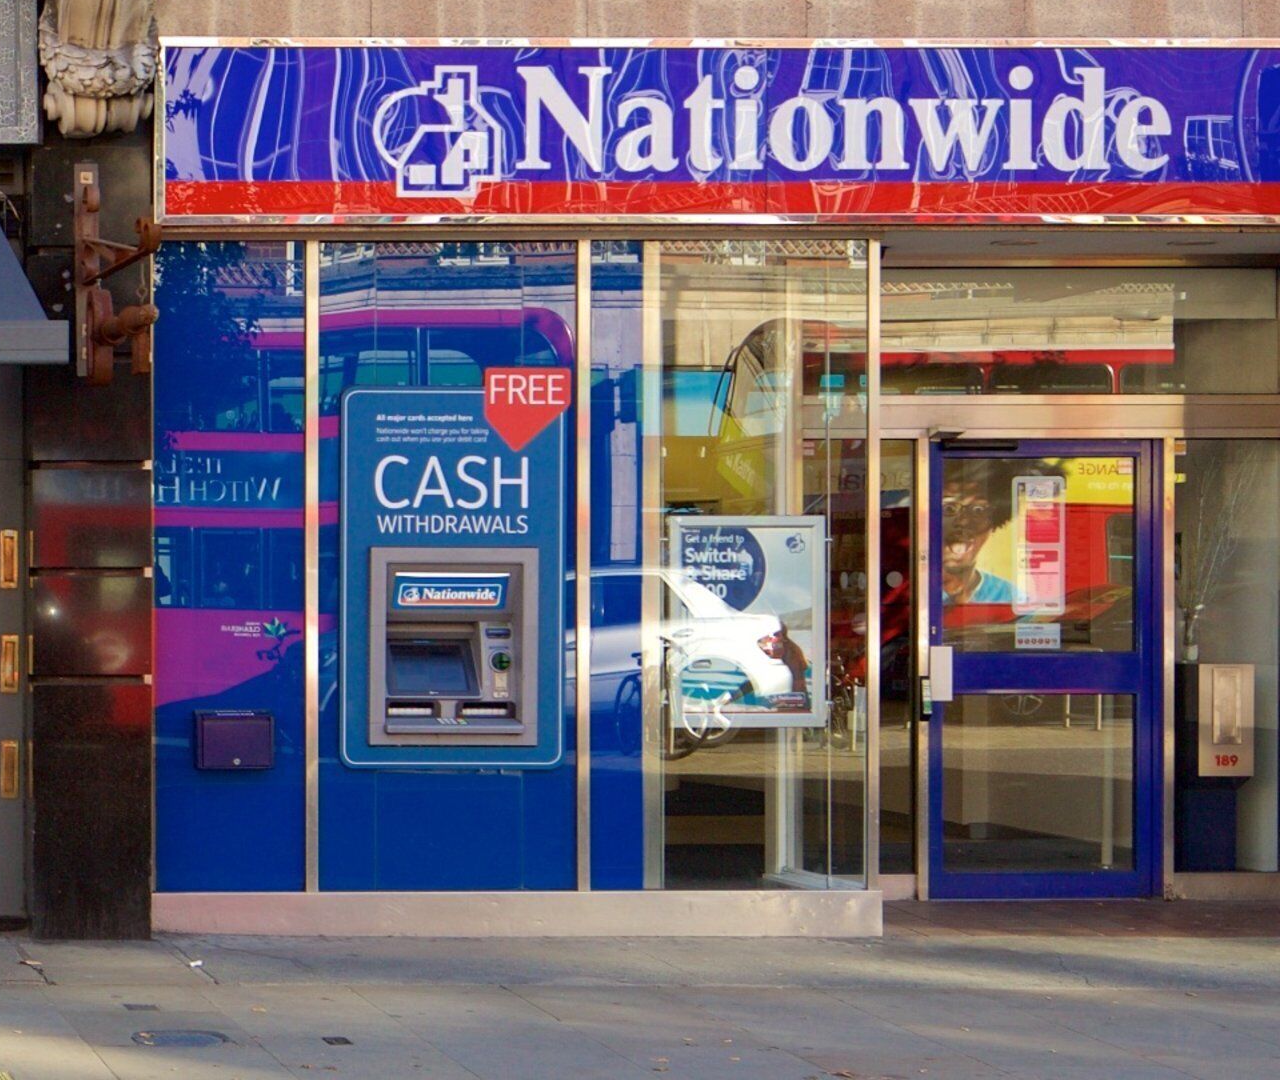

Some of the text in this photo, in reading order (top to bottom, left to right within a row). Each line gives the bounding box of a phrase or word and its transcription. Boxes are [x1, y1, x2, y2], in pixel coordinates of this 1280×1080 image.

[514, 63, 1171, 174] Nationwide
[489, 373, 566, 405] FREE
[387, 414, 406, 422] major
[427, 414, 457, 422] accepted
[373, 455, 530, 510] CASH
[376, 514, 529, 535] WITHDRAWALS
[685, 547, 737, 563] Switch
[701, 565, 747, 581] Share
[422, 588, 496, 600] Nationwide
[1214, 754, 1238, 766] 189
